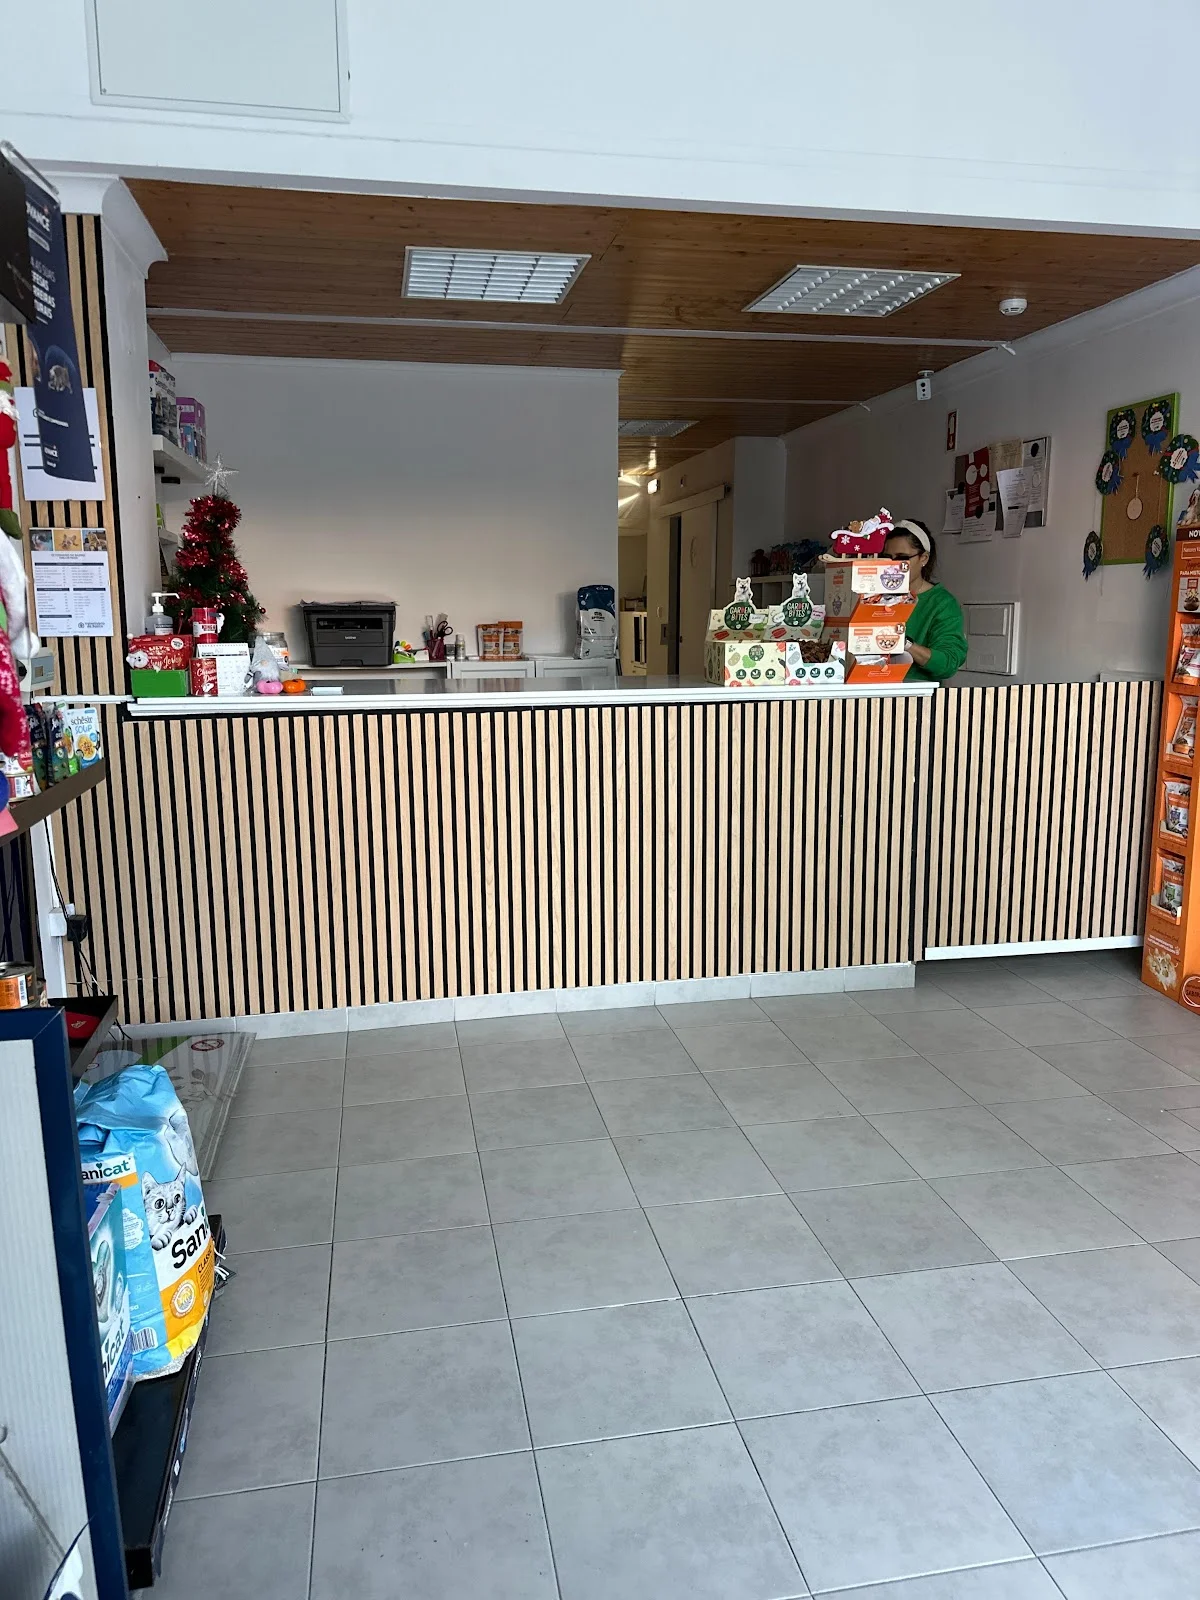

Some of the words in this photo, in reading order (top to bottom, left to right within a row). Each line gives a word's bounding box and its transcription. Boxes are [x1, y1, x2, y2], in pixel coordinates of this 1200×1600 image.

[729, 606, 752, 616] GARDEN
[786, 601, 810, 611] GARDEN
[730, 613, 748, 622] BITES
[788, 609, 805, 618] BITES
[74, 725, 93, 735] SOUP
[82, 1160, 130, 1181] anicat
